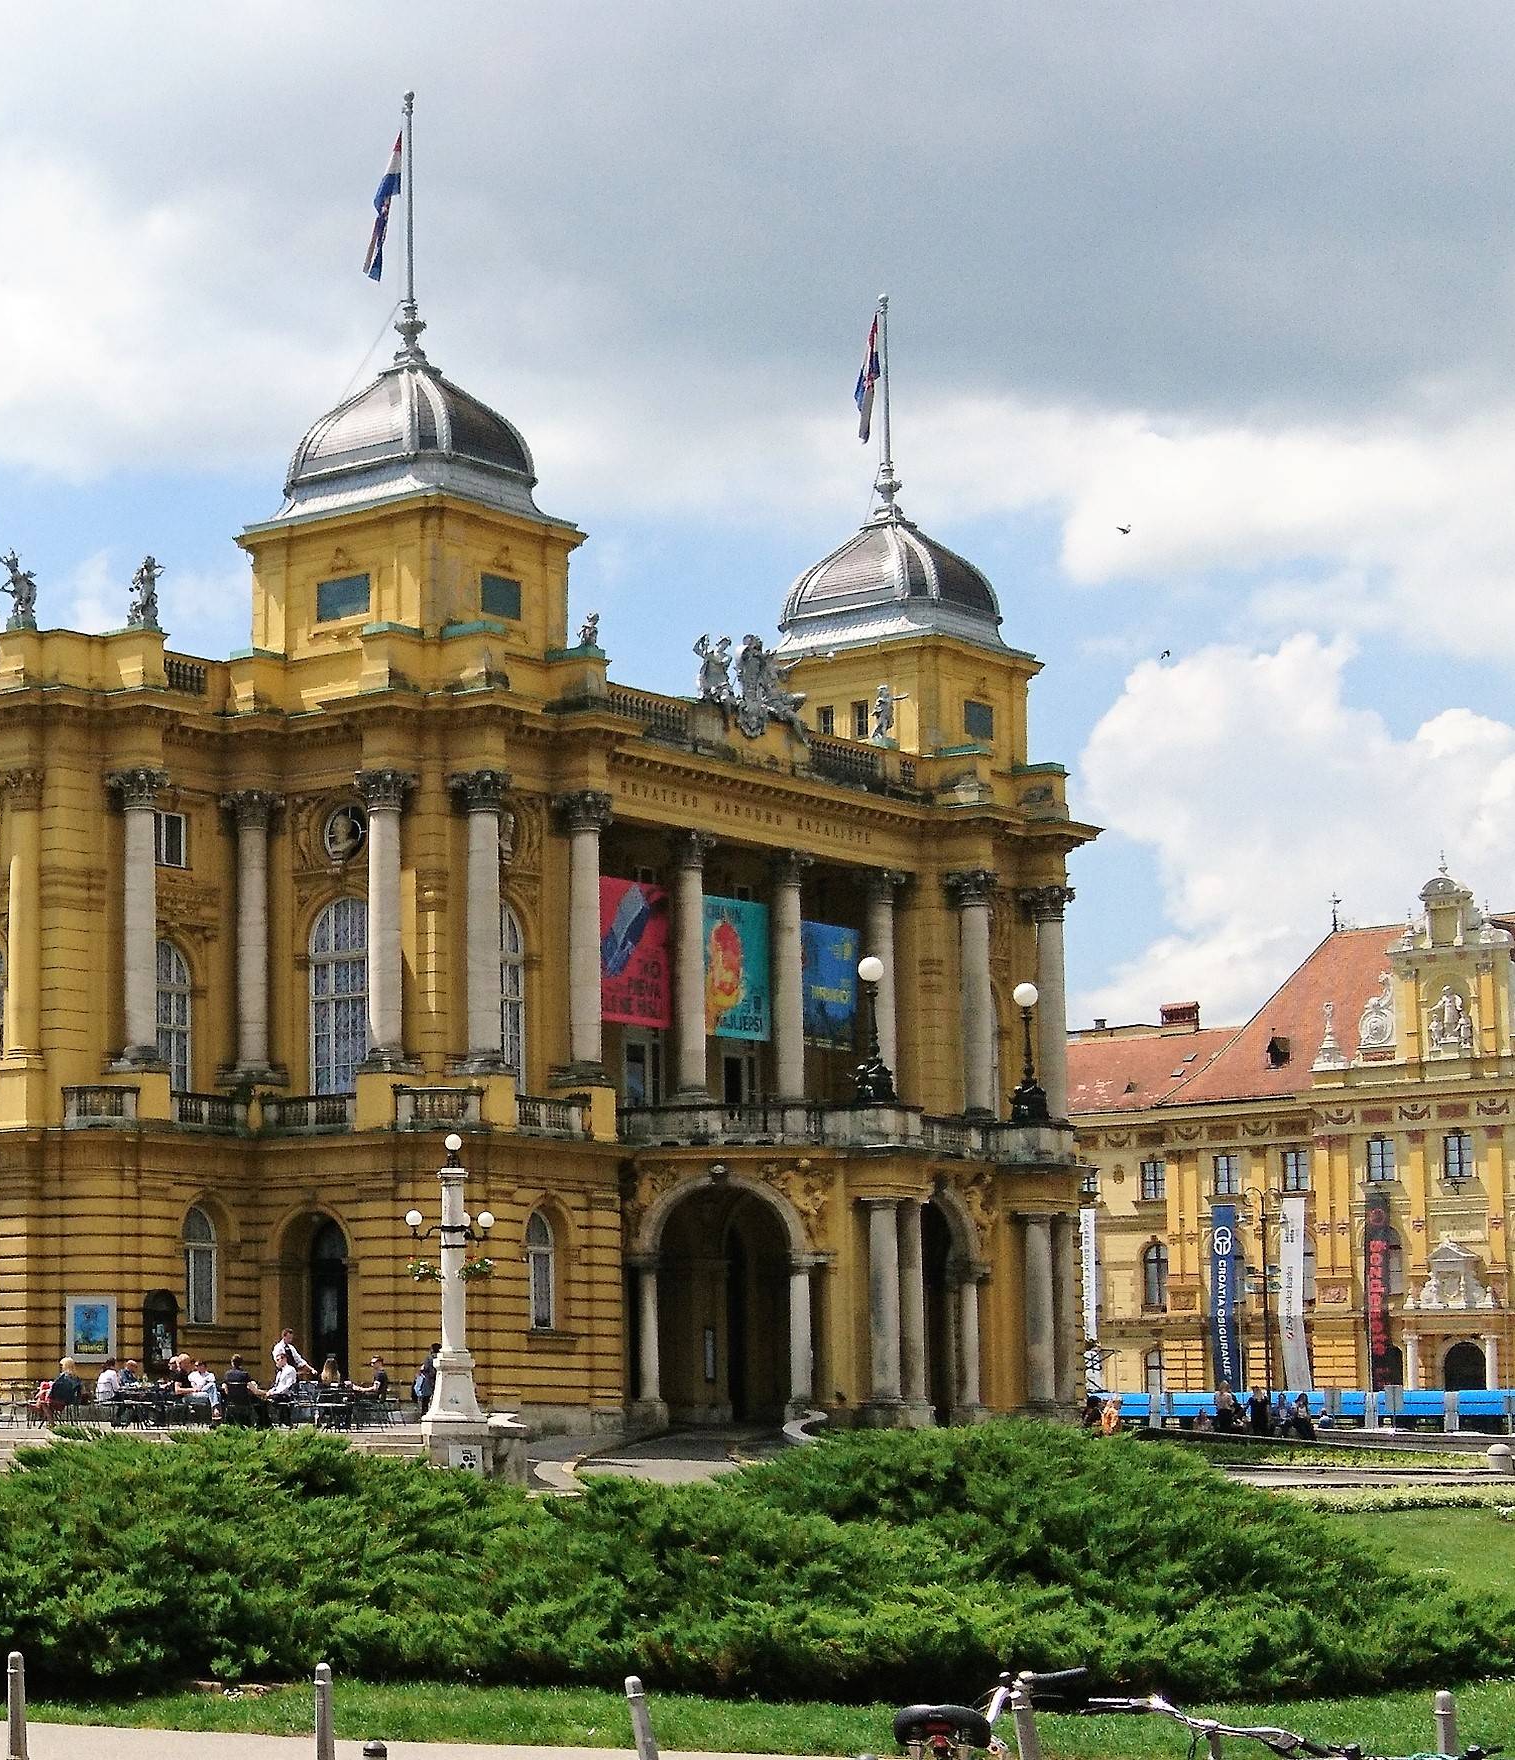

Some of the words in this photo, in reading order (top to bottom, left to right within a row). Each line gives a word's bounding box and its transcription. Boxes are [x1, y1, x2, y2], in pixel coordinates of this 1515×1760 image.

[620, 780, 698, 808] HRVATSKO
[714, 801, 782, 826] NARODNO
[1217, 1259, 1227, 1306] CROATIA
[1217, 1308, 1232, 1376] OSIGURANJE
